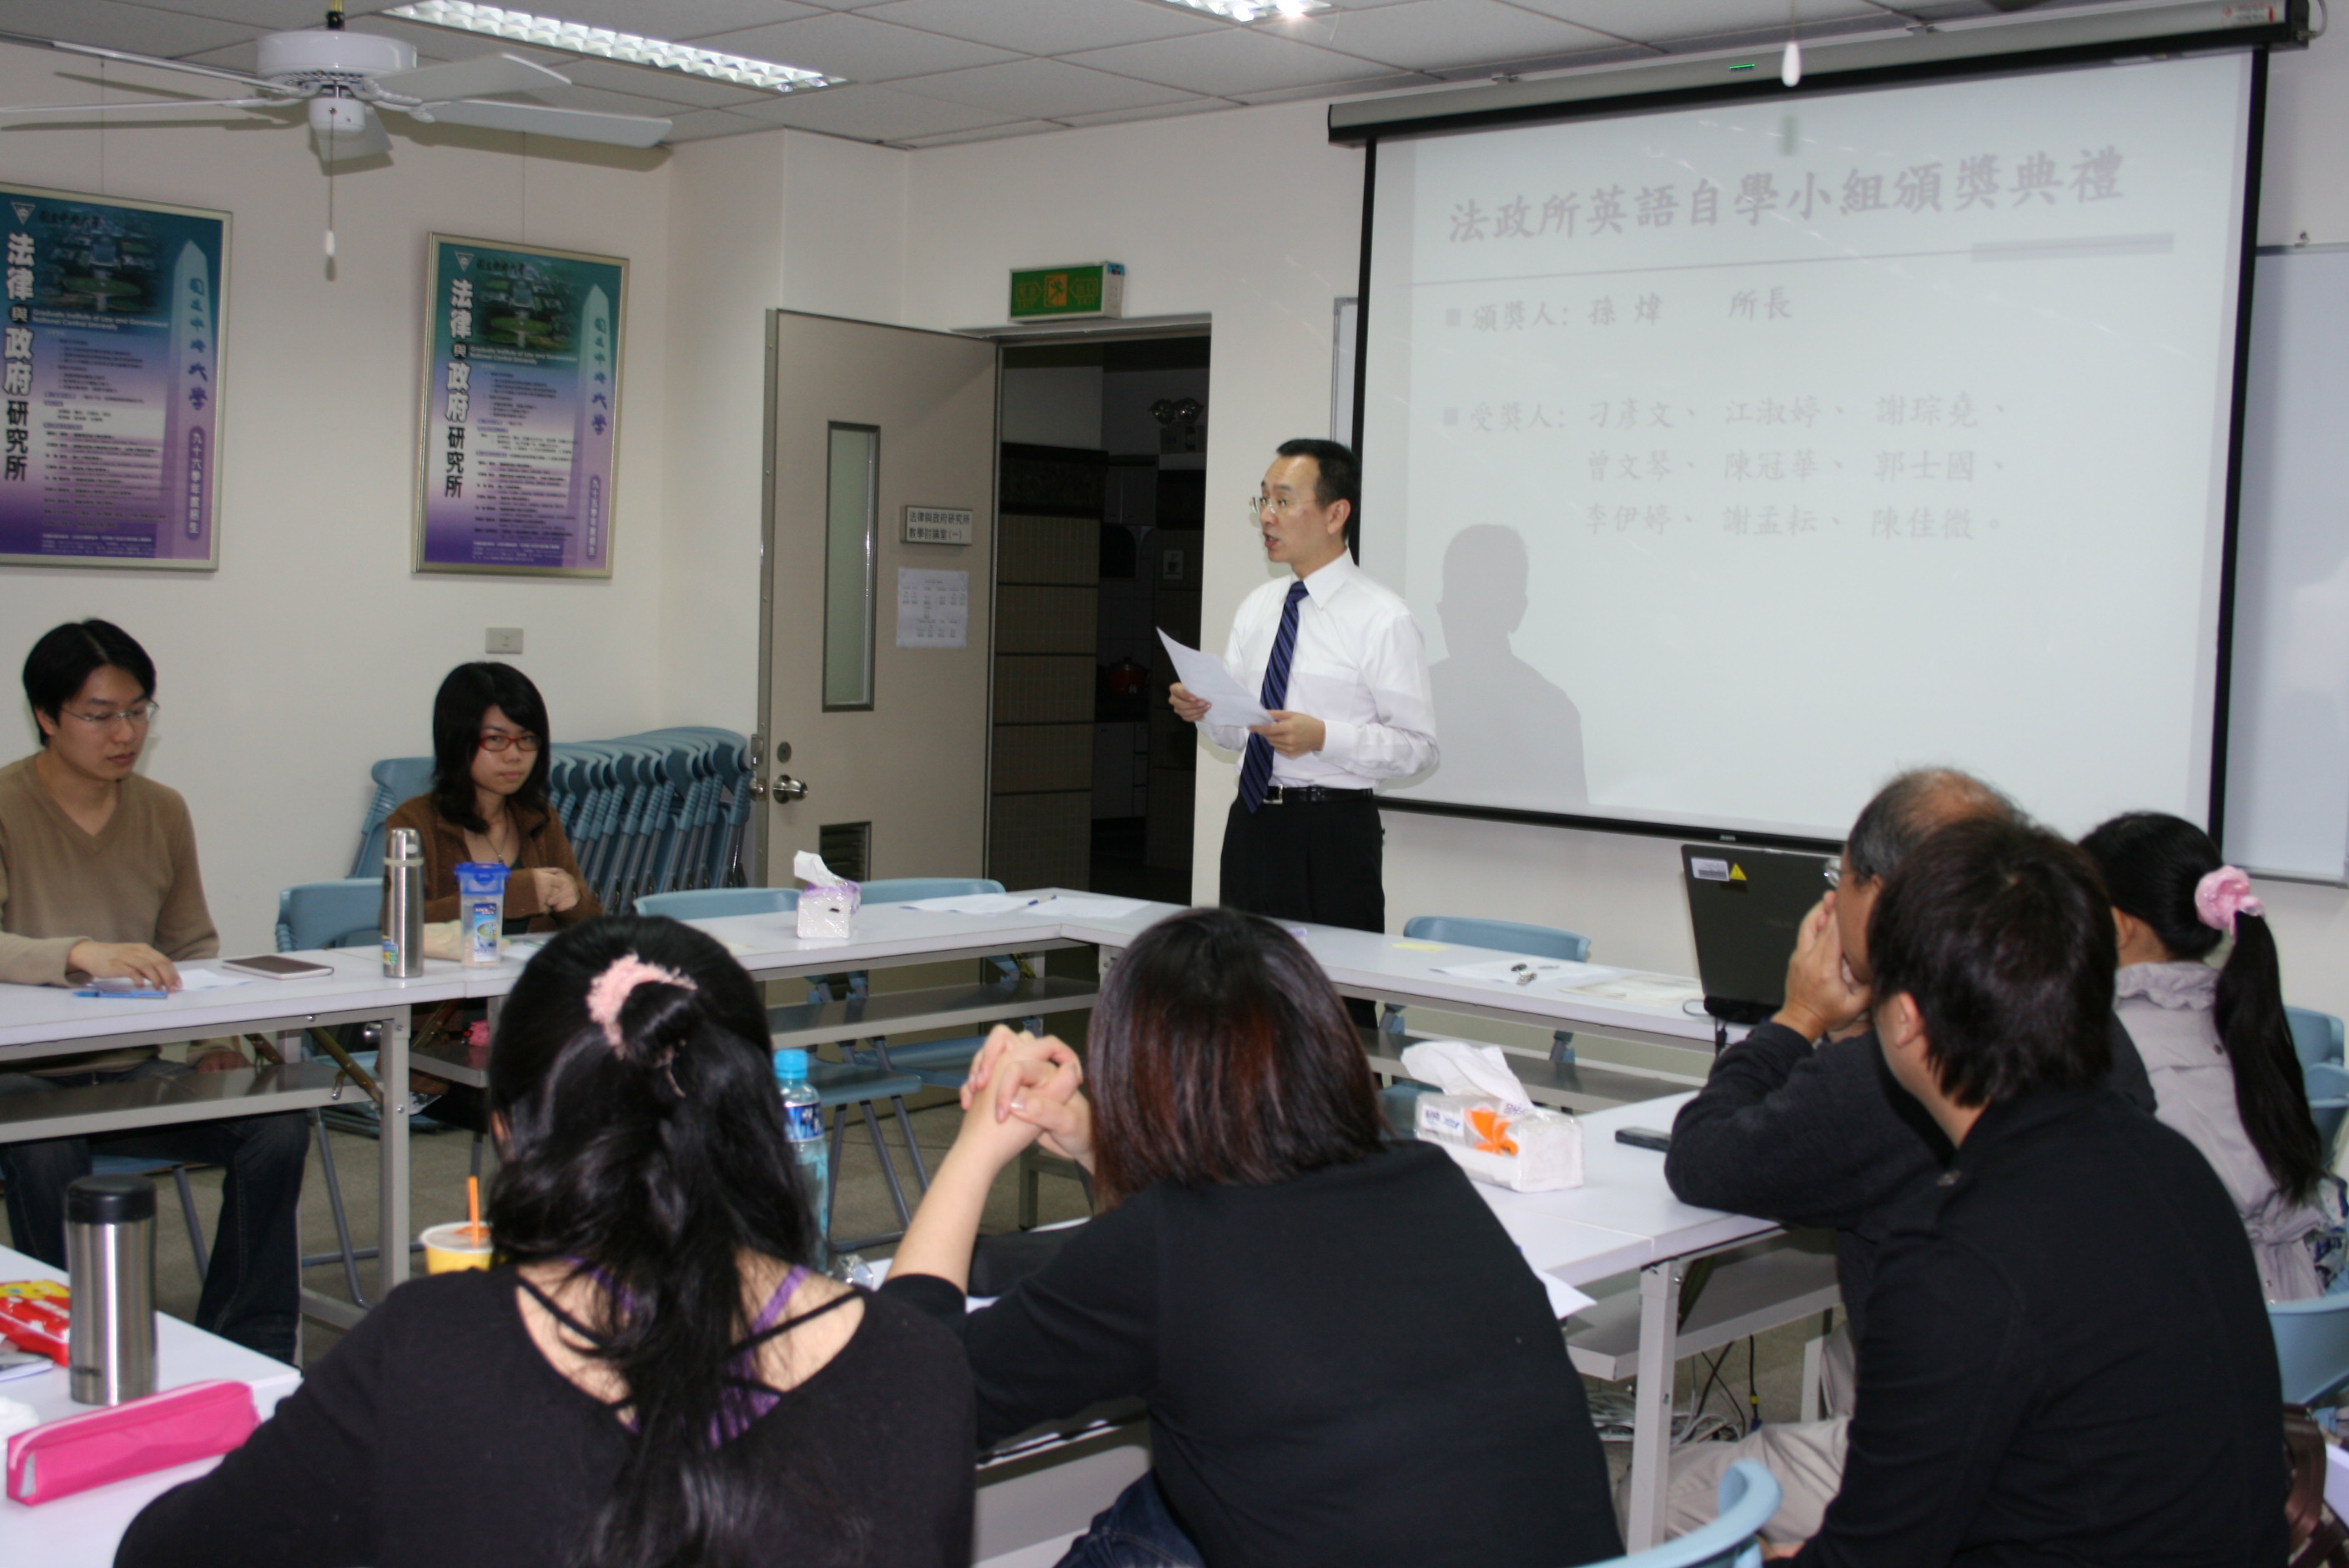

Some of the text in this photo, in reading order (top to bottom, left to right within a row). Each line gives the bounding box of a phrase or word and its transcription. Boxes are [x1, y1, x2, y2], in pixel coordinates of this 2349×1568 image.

[1448, 143, 2127, 244] 法政所英語自學小組頒獎典禮
[1728, 286, 1793, 321] 所長
[3, 232, 37, 482] 法律與政府研究所
[445, 278, 474, 500] 法律與政府研究所
[908, 510, 971, 526] 法律與政府研究所
